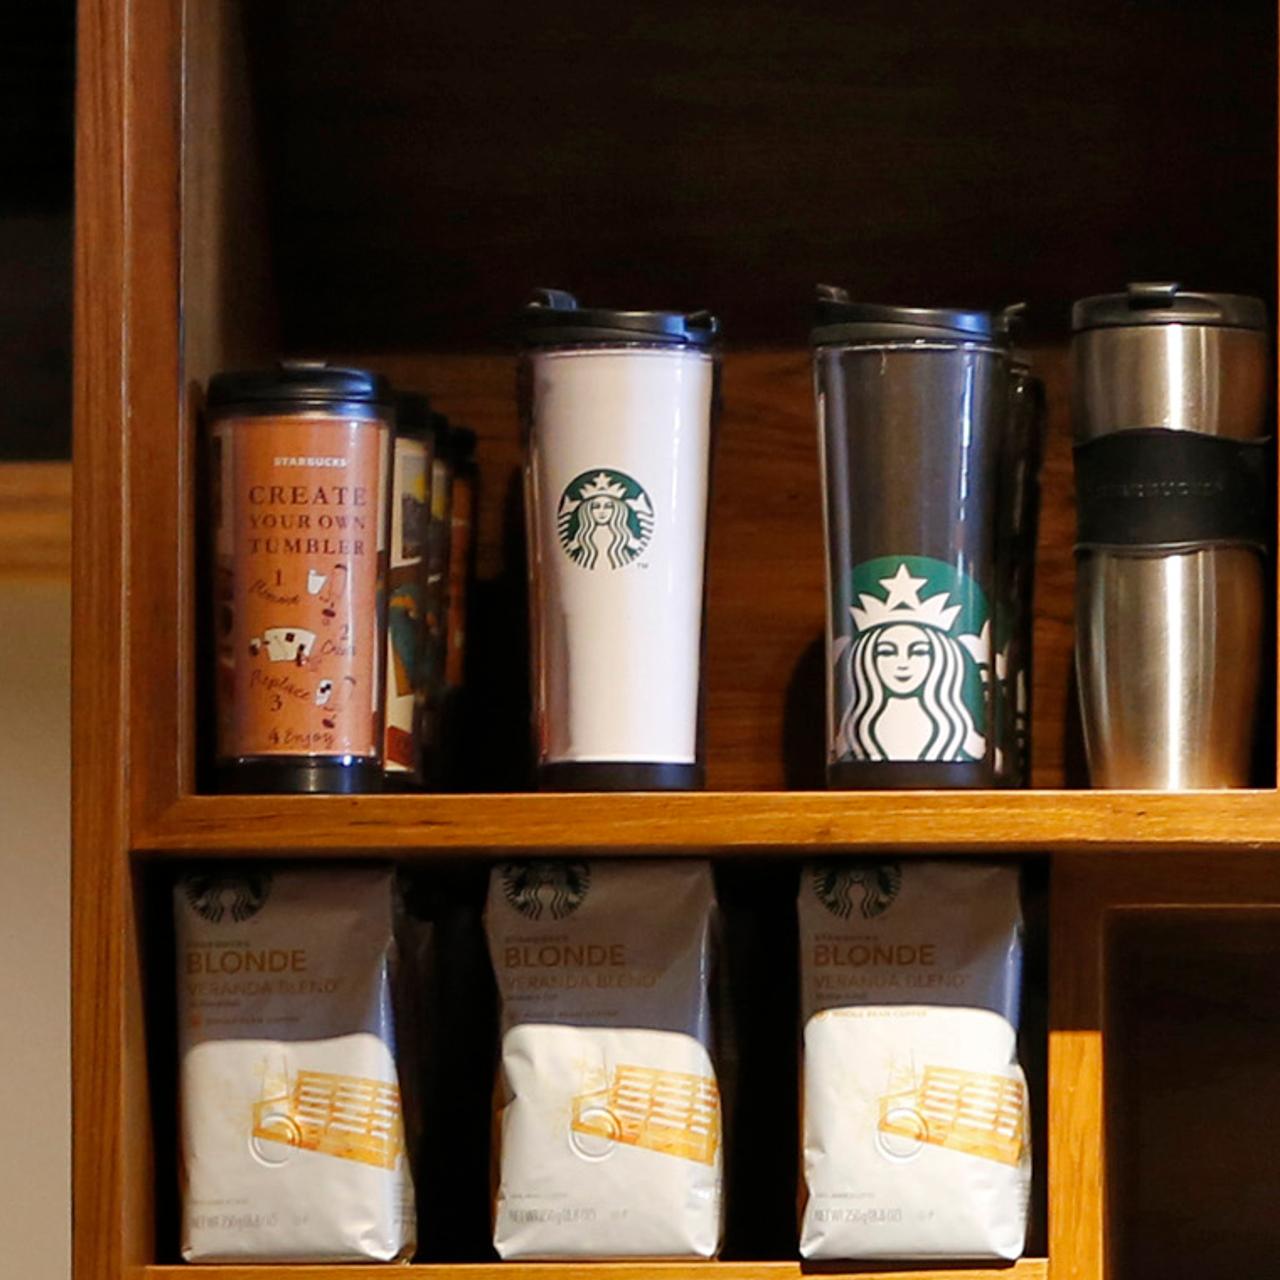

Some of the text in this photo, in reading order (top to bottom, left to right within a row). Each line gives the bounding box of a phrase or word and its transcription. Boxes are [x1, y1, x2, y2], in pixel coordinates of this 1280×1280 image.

[273, 456, 348, 468] STARBUCKS
[248, 485, 368, 507] CREATE
[249, 513, 366, 530] YOUR OWN
[248, 538, 366, 556] TUMBLER
[186, 950, 307, 974] BLONDE
[504, 944, 626, 968] BLONDE
[813, 944, 936, 967] BLONDE
